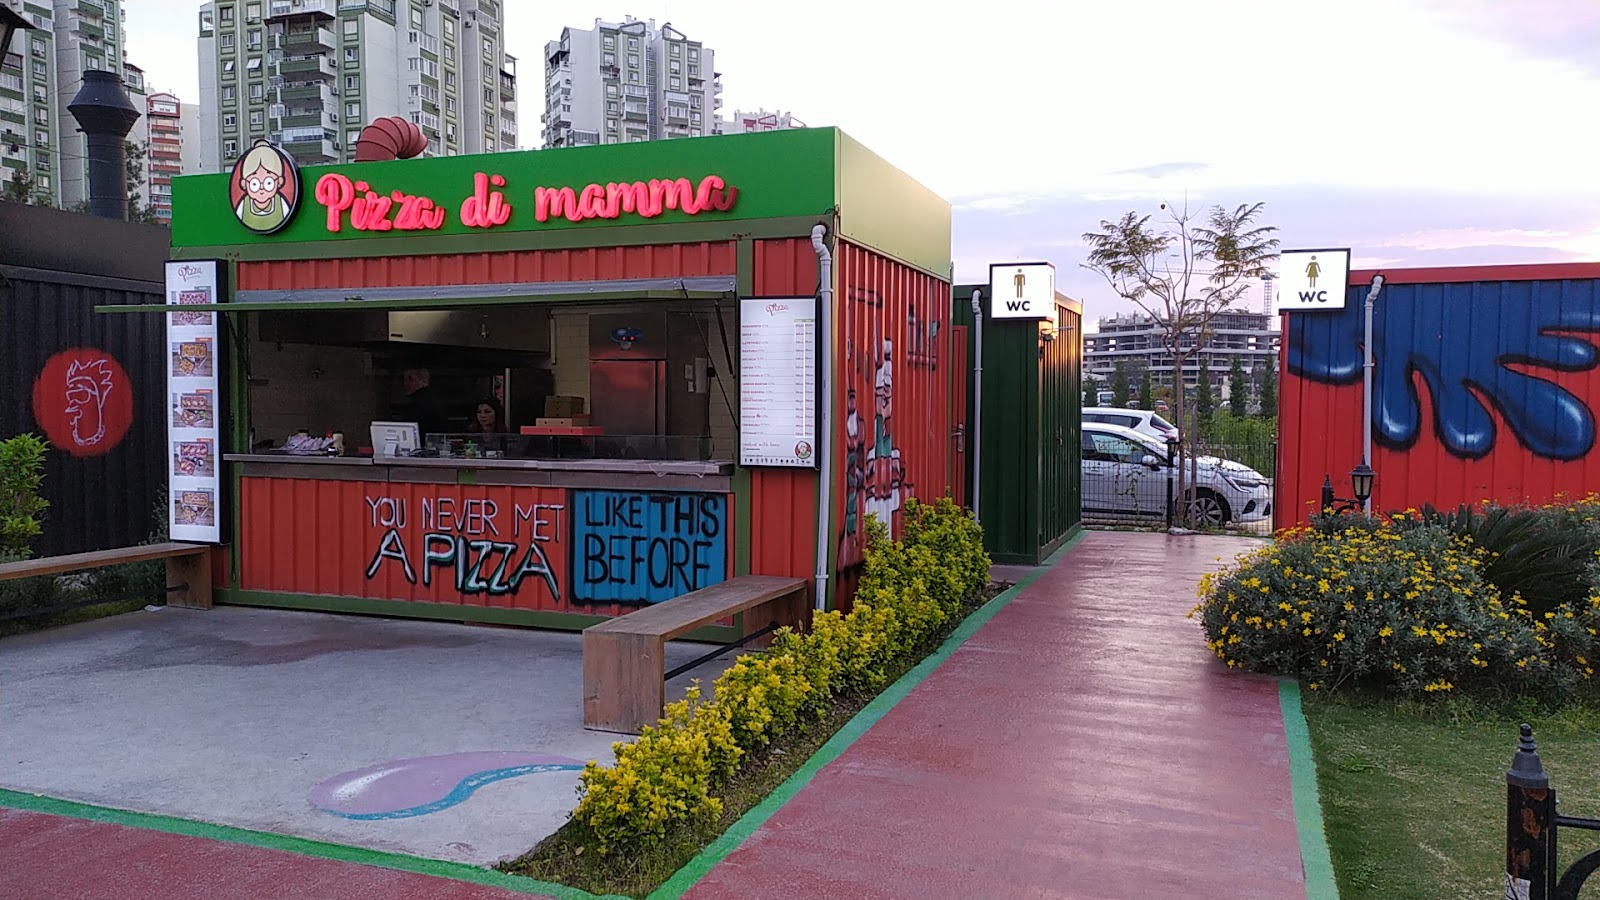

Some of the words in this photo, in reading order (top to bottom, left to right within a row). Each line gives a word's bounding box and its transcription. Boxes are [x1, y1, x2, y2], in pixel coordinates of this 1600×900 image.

[315, 172, 445, 232] Pizza
[460, 171, 512, 228] di
[534, 174, 738, 222] mamma
[766, 303, 789, 316] Pizza
[1006, 300, 1031, 312] WC
[1299, 290, 1327, 303] WC
[366, 495, 407, 529] YOU
[422, 497, 499, 536] NEVER
[514, 503, 565, 542] MET
[585, 496, 643, 529] LIKE
[651, 495, 719, 538] THIS
[366, 528, 417, 584] A
[423, 531, 561, 603] PIZZA
